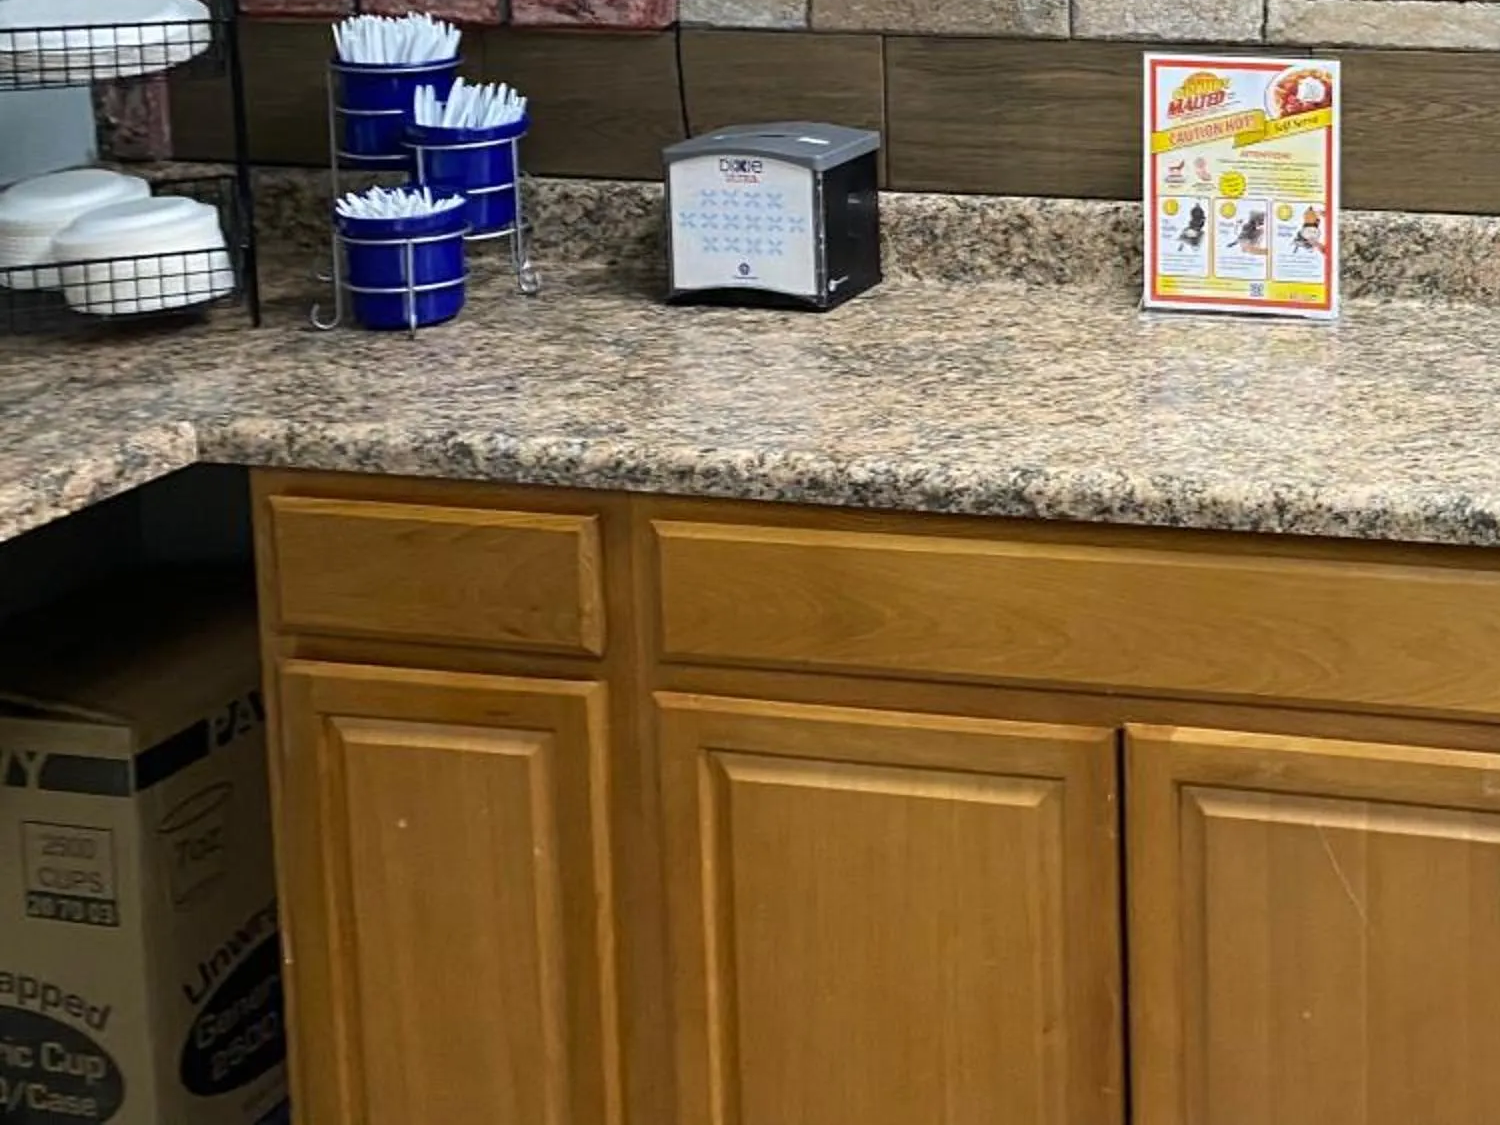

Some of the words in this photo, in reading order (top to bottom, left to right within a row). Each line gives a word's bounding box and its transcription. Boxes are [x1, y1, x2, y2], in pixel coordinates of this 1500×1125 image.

[1168, 120, 1224, 146] CAUTION
[37, 866, 104, 893] CUPS
[40, 1041, 107, 1086] Cup
